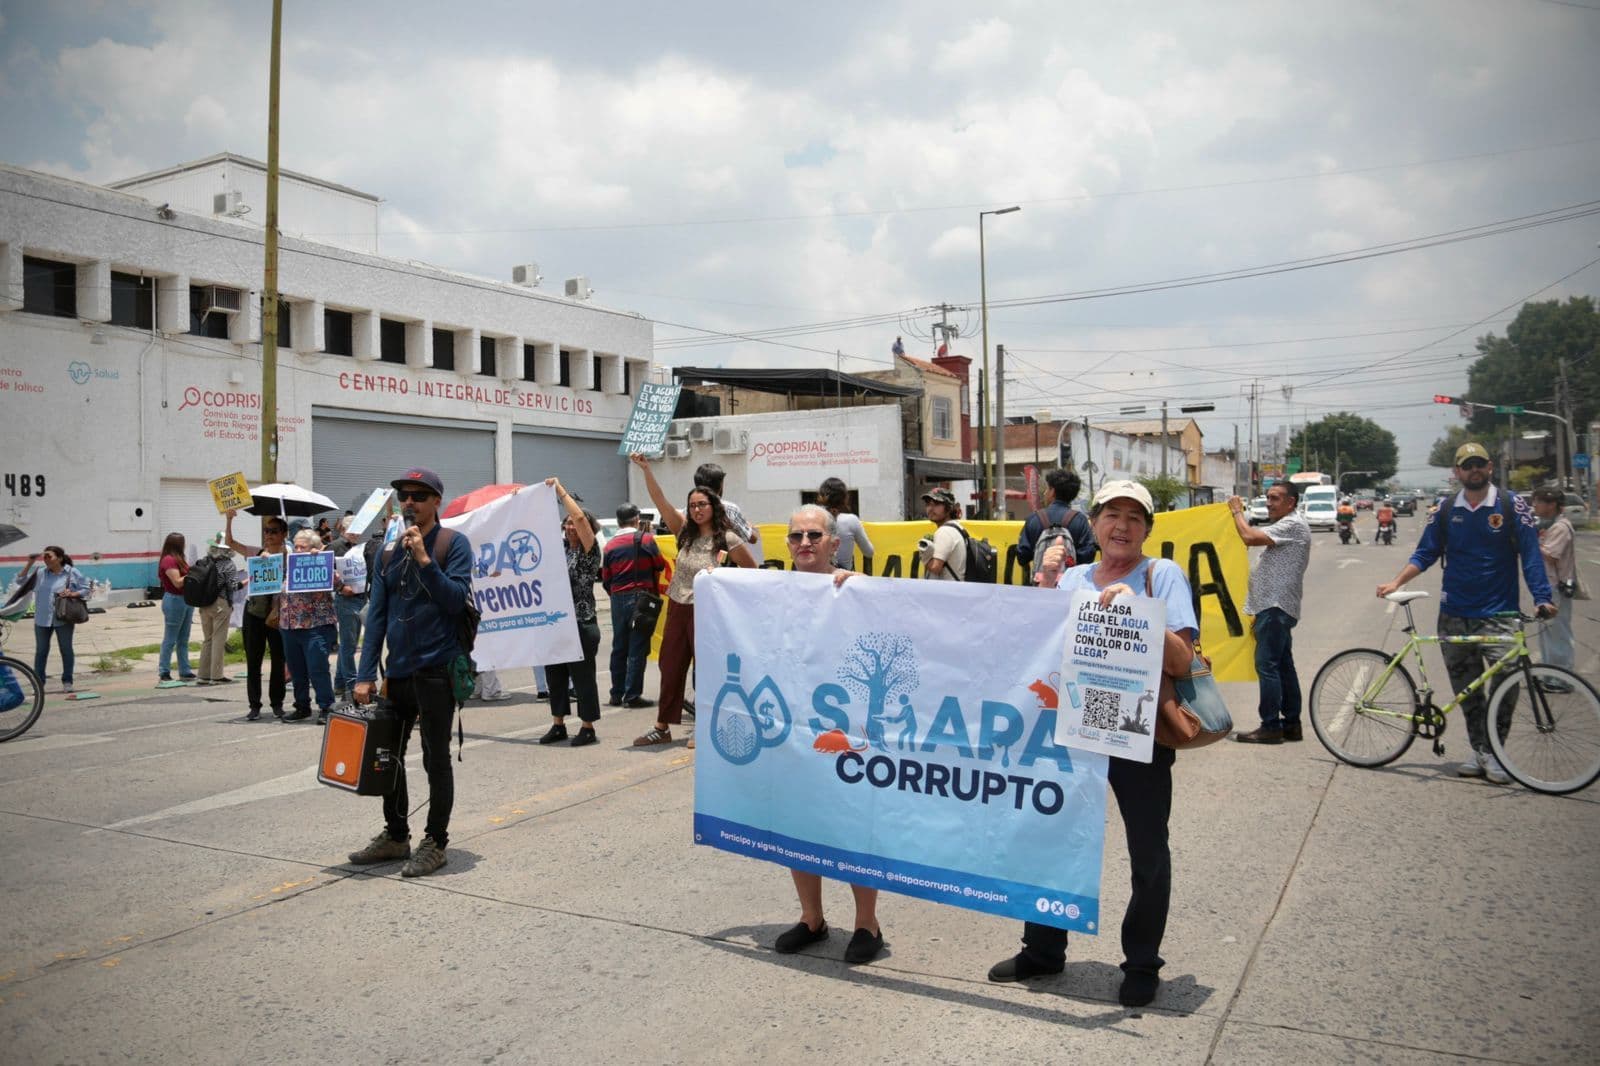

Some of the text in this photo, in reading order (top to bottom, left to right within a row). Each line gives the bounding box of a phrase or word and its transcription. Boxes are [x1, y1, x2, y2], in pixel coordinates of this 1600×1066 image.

[95, 369, 119, 379] Salud
[203, 390, 261, 409] COPRISJ
[339, 372, 593, 414] CENTRO INTEGRAL DE SERVICIOS
[633, 410, 648, 420] NO
[766, 441, 826, 454] COPRISJAL
[0, 473, 46, 497] 489
[471, 541, 522, 578] PA
[293, 566, 328, 583] CLORO
[474, 579, 543, 613] remos
[1105, 603, 1132, 616] CASA
[1078, 611, 1149, 631] LLEGA EL AGUA
[1104, 626, 1143, 642] TURBIA,
[1073, 645, 1108, 660] LLEGA?
[1075, 634, 1148, 654] CON OLOR O NO
[836, 751, 1064, 815] CORRUPTO
[720, 830, 751, 846] Participa
[784, 848, 821, 865] campaña
[821, 858, 834, 868] en:
[963, 886, 1008, 903] @upojast
